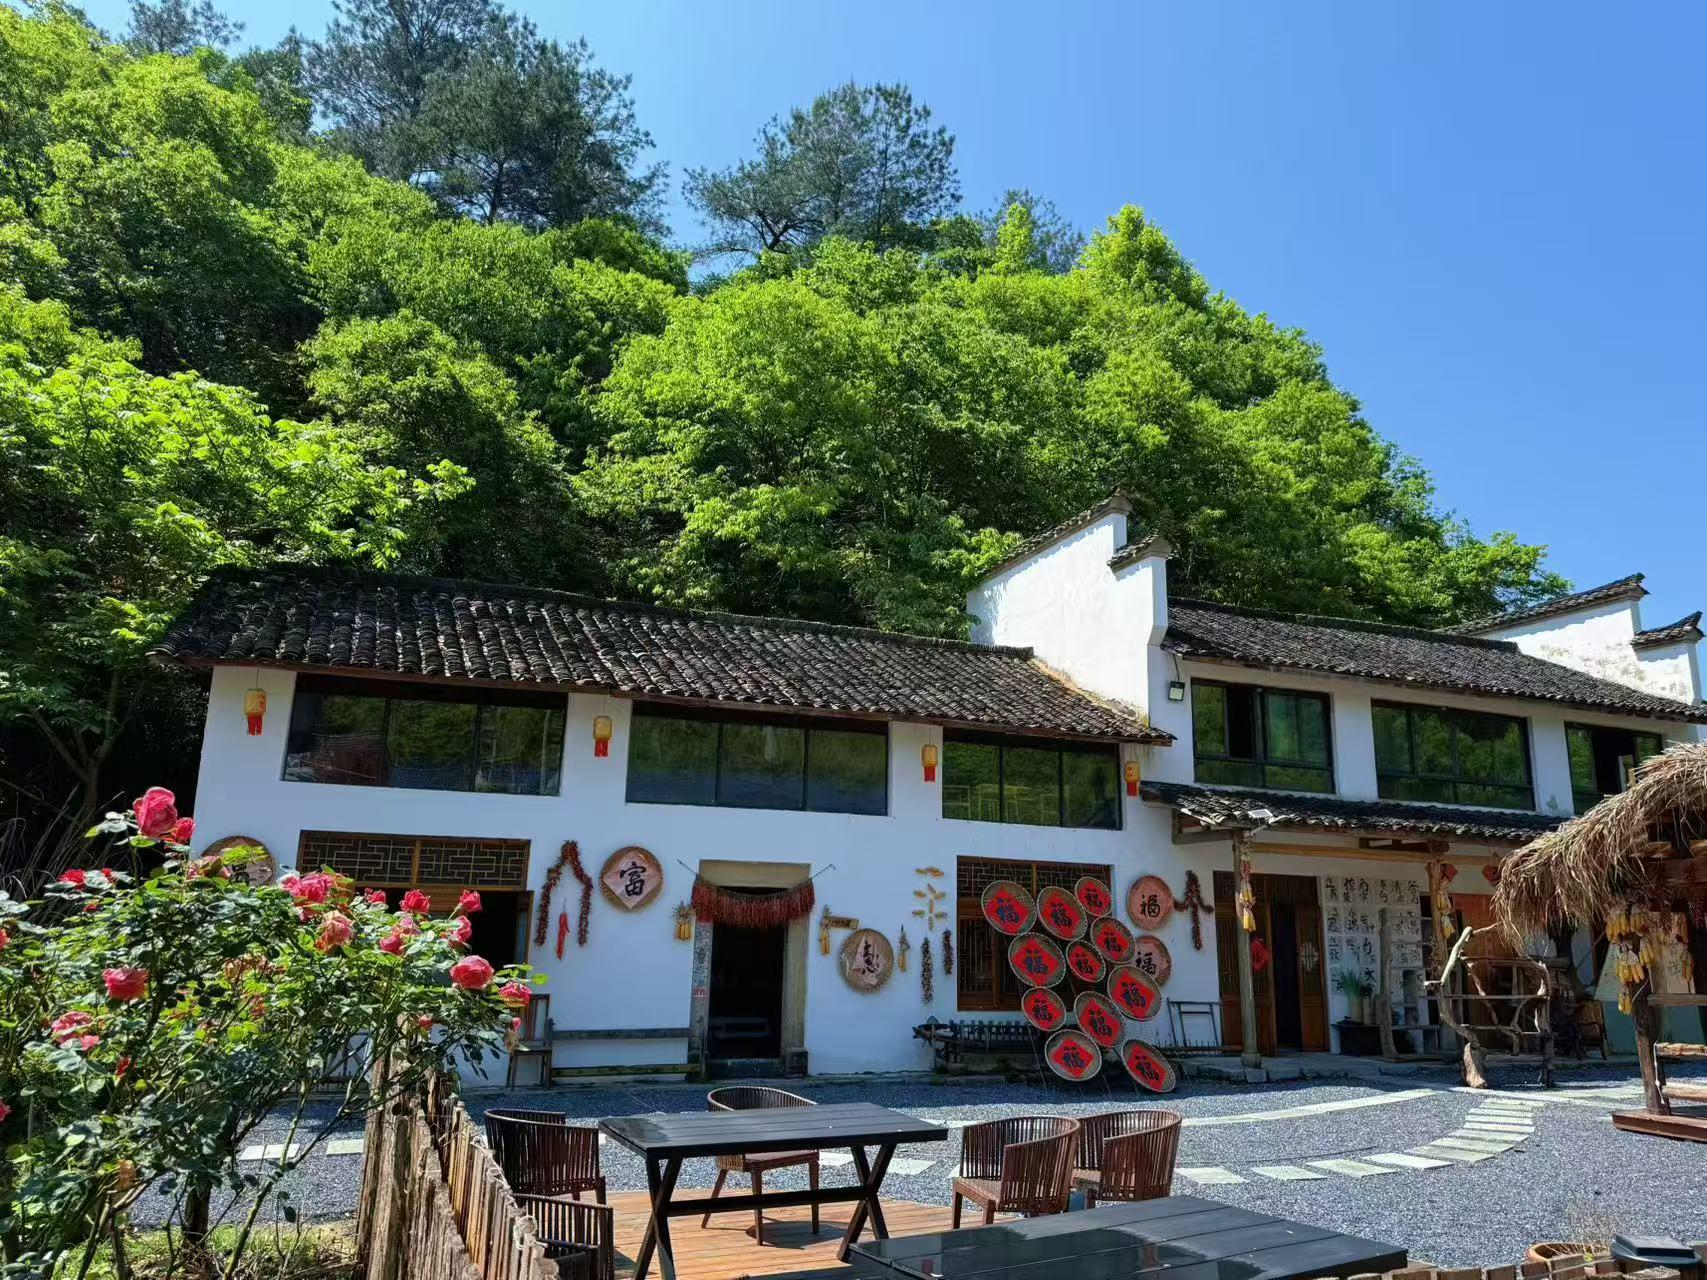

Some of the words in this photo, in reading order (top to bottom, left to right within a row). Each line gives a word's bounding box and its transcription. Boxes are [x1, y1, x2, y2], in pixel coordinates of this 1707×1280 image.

[619, 861, 647, 897] 富
[1050, 903, 1073, 928] 福
[1141, 894, 1160, 917] 福
[1103, 931, 1121, 953] 福
[1024, 948, 1048, 974] 福
[1076, 954, 1094, 975] 福
[1136, 952, 1156, 975] 福
